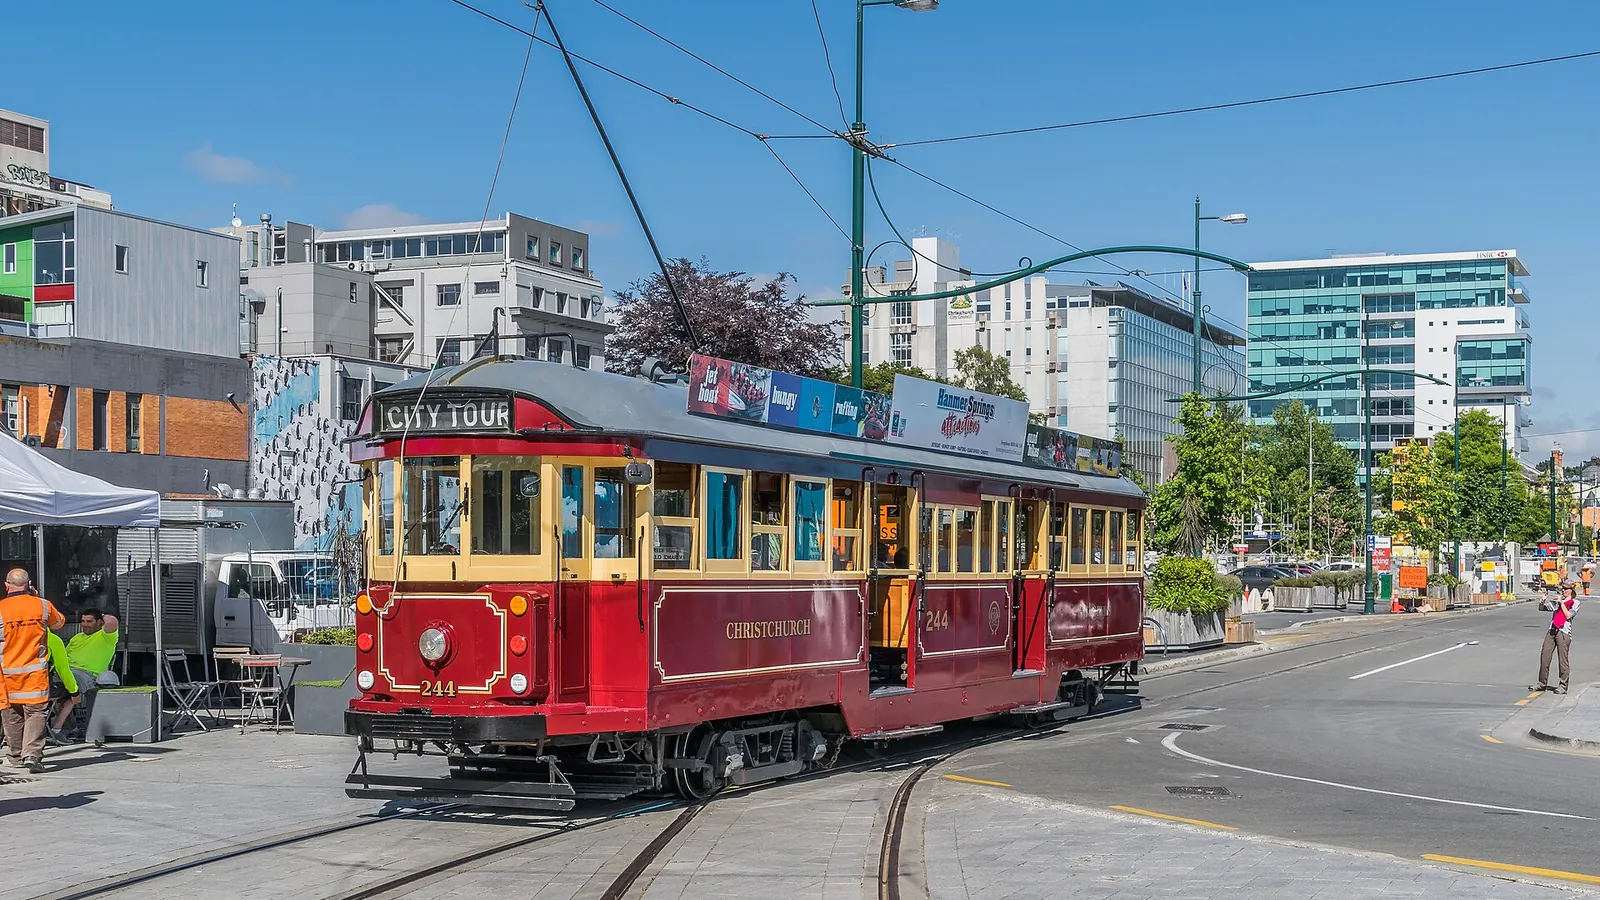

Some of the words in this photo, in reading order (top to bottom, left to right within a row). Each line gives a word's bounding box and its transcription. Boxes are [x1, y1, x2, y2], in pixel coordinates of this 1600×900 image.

[704, 365, 718, 386] jet
[698, 384, 719, 404] boat
[771, 386, 798, 411] bungy
[937, 387, 968, 411] Hanmer
[967, 395, 995, 422] Springs
[387, 404, 441, 429] CITY
[447, 401, 509, 427] TOUR
[834, 401, 859, 421] rafting
[1372, 549, 1386, 557] ublic
[1372, 557, 1389, 566] arking
[726, 618, 812, 640] CHRISTCHURCH
[925, 610, 949, 632] 244
[421, 680, 456, 698] 244
